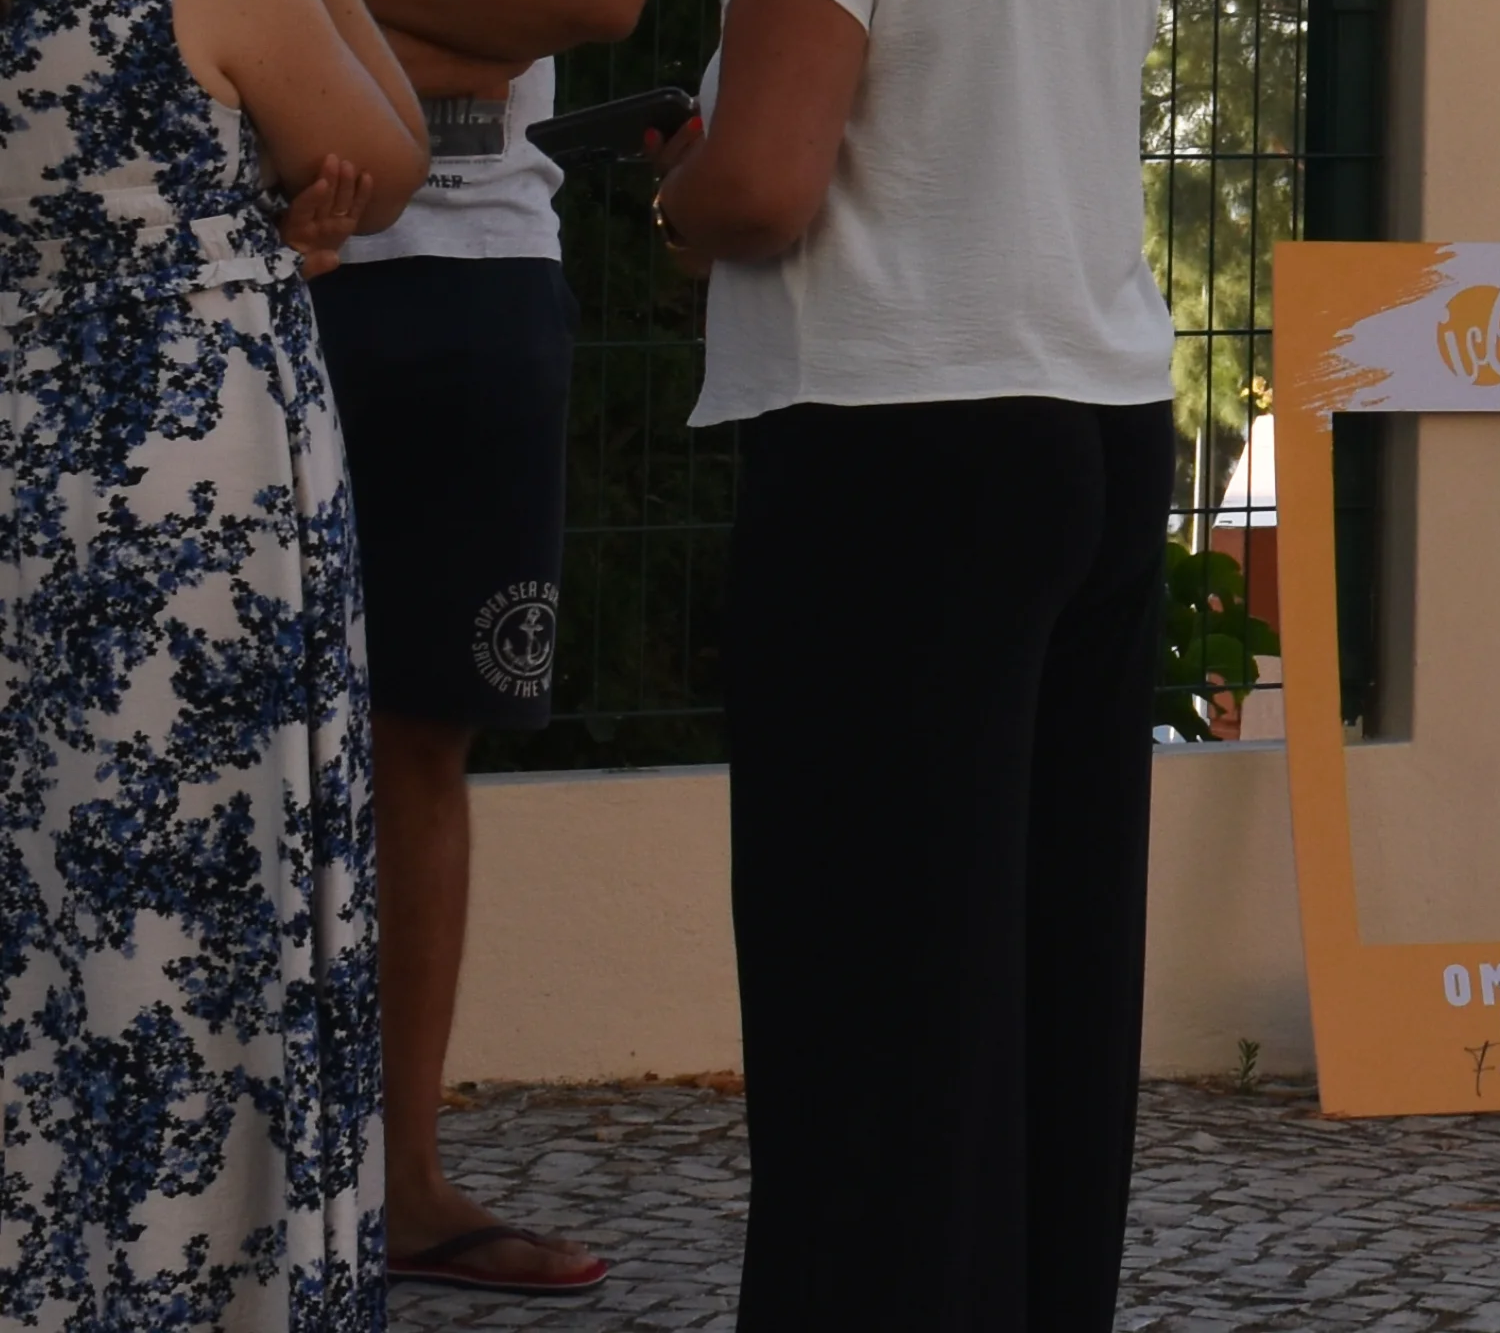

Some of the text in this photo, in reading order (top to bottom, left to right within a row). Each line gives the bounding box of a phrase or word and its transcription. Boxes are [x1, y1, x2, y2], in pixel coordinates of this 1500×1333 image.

[474, 591, 508, 629] OPEN
[508, 580, 537, 601] SEA
[472, 641, 512, 692] SAILING
[514, 680, 539, 697] THE
[1443, 964, 1472, 1006] O
